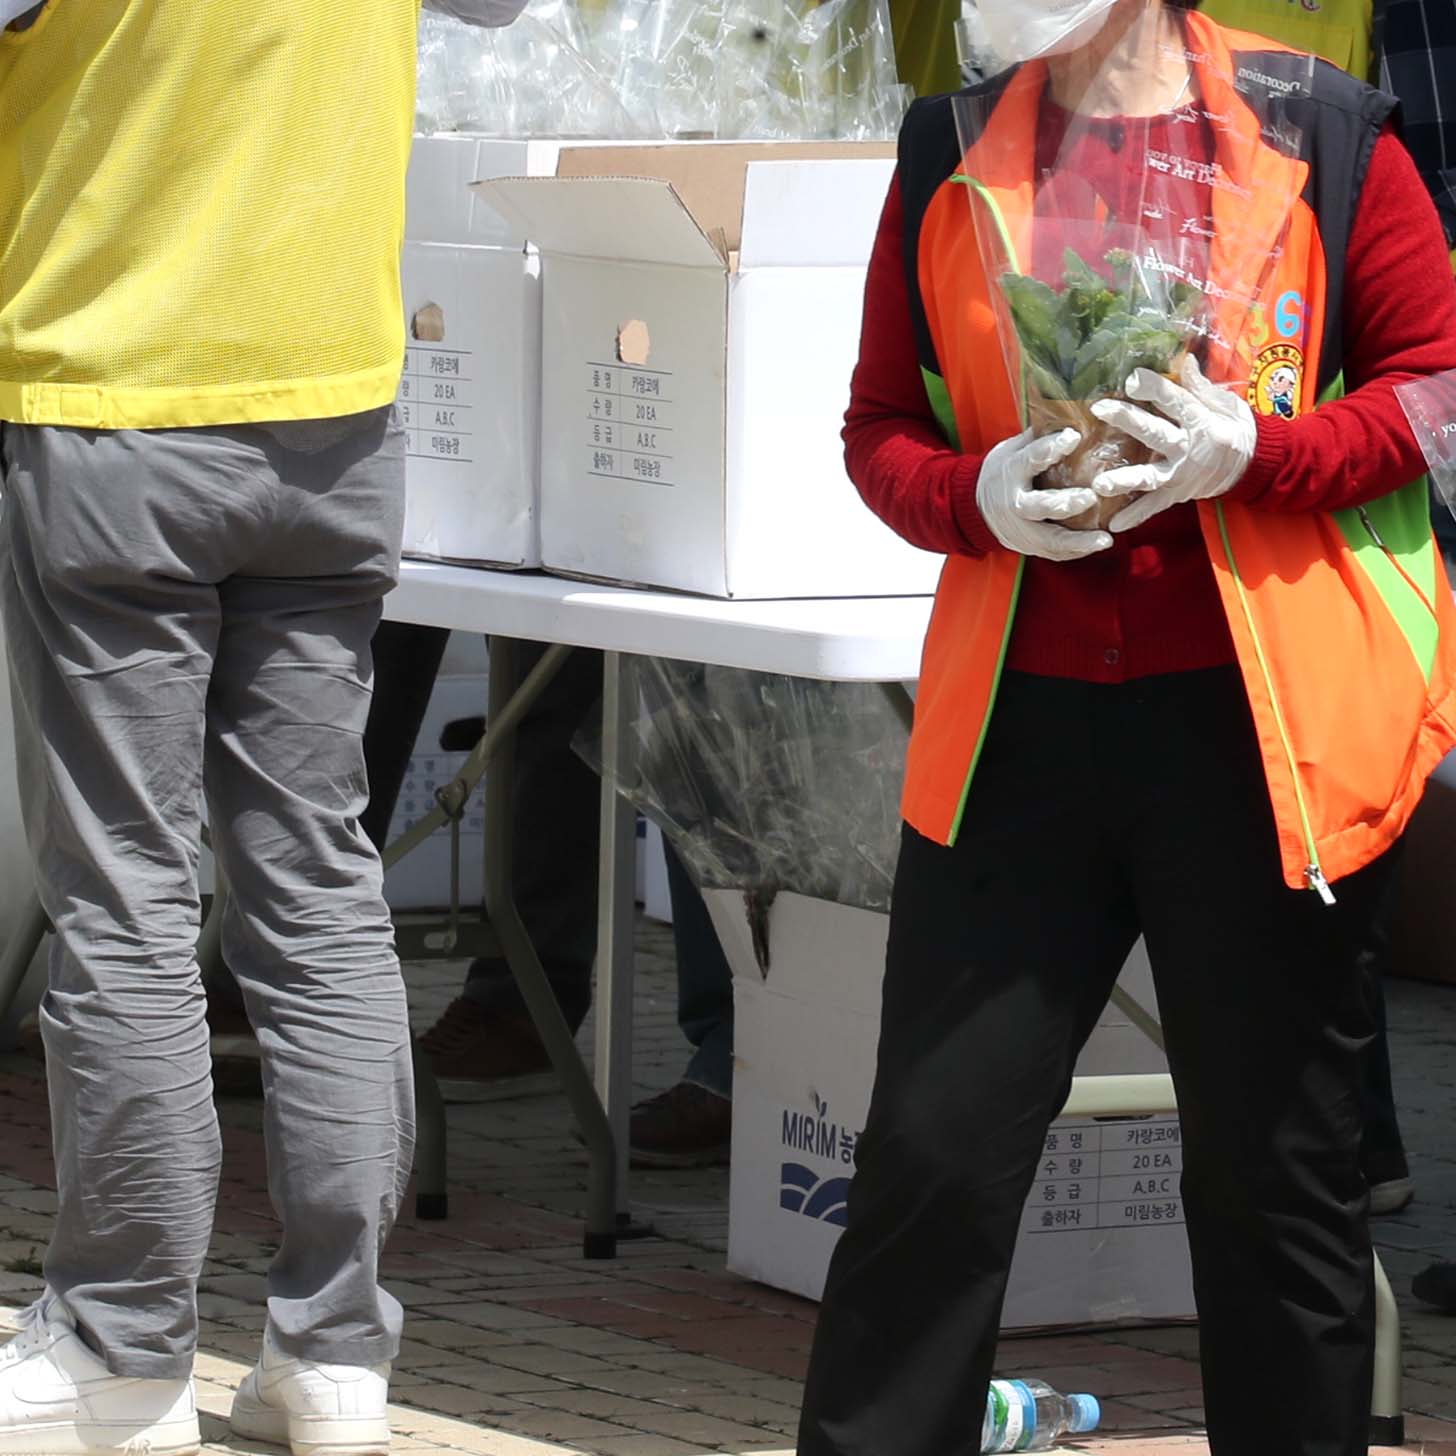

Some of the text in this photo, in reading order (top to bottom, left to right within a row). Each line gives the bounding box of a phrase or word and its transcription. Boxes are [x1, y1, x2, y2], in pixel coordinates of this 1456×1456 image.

[782, 1107, 836, 1160] MIRIM
[1133, 1155, 1150, 1169] 20
[1154, 1154, 1172, 1168] EA
